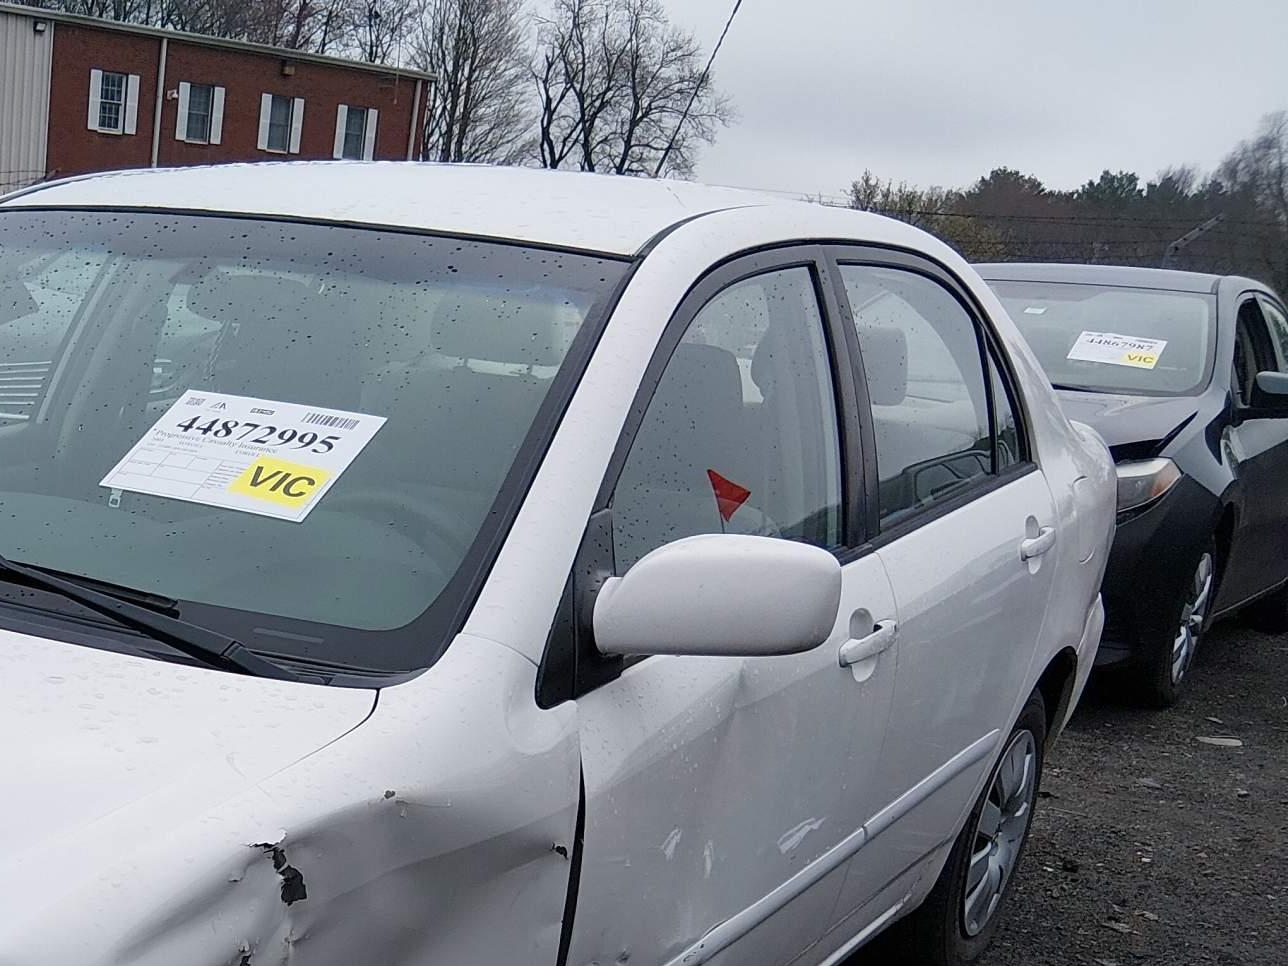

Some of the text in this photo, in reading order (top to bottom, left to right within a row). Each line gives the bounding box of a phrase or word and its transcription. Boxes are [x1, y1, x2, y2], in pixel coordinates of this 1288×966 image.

[1127, 353, 1154, 364] VIC
[155, 429, 200, 442] Progressive
[202, 436, 237, 449] Casualty
[239, 441, 279, 454] Insurance
[177, 415, 343, 455] 44872995
[248, 465, 316, 498] VIC
